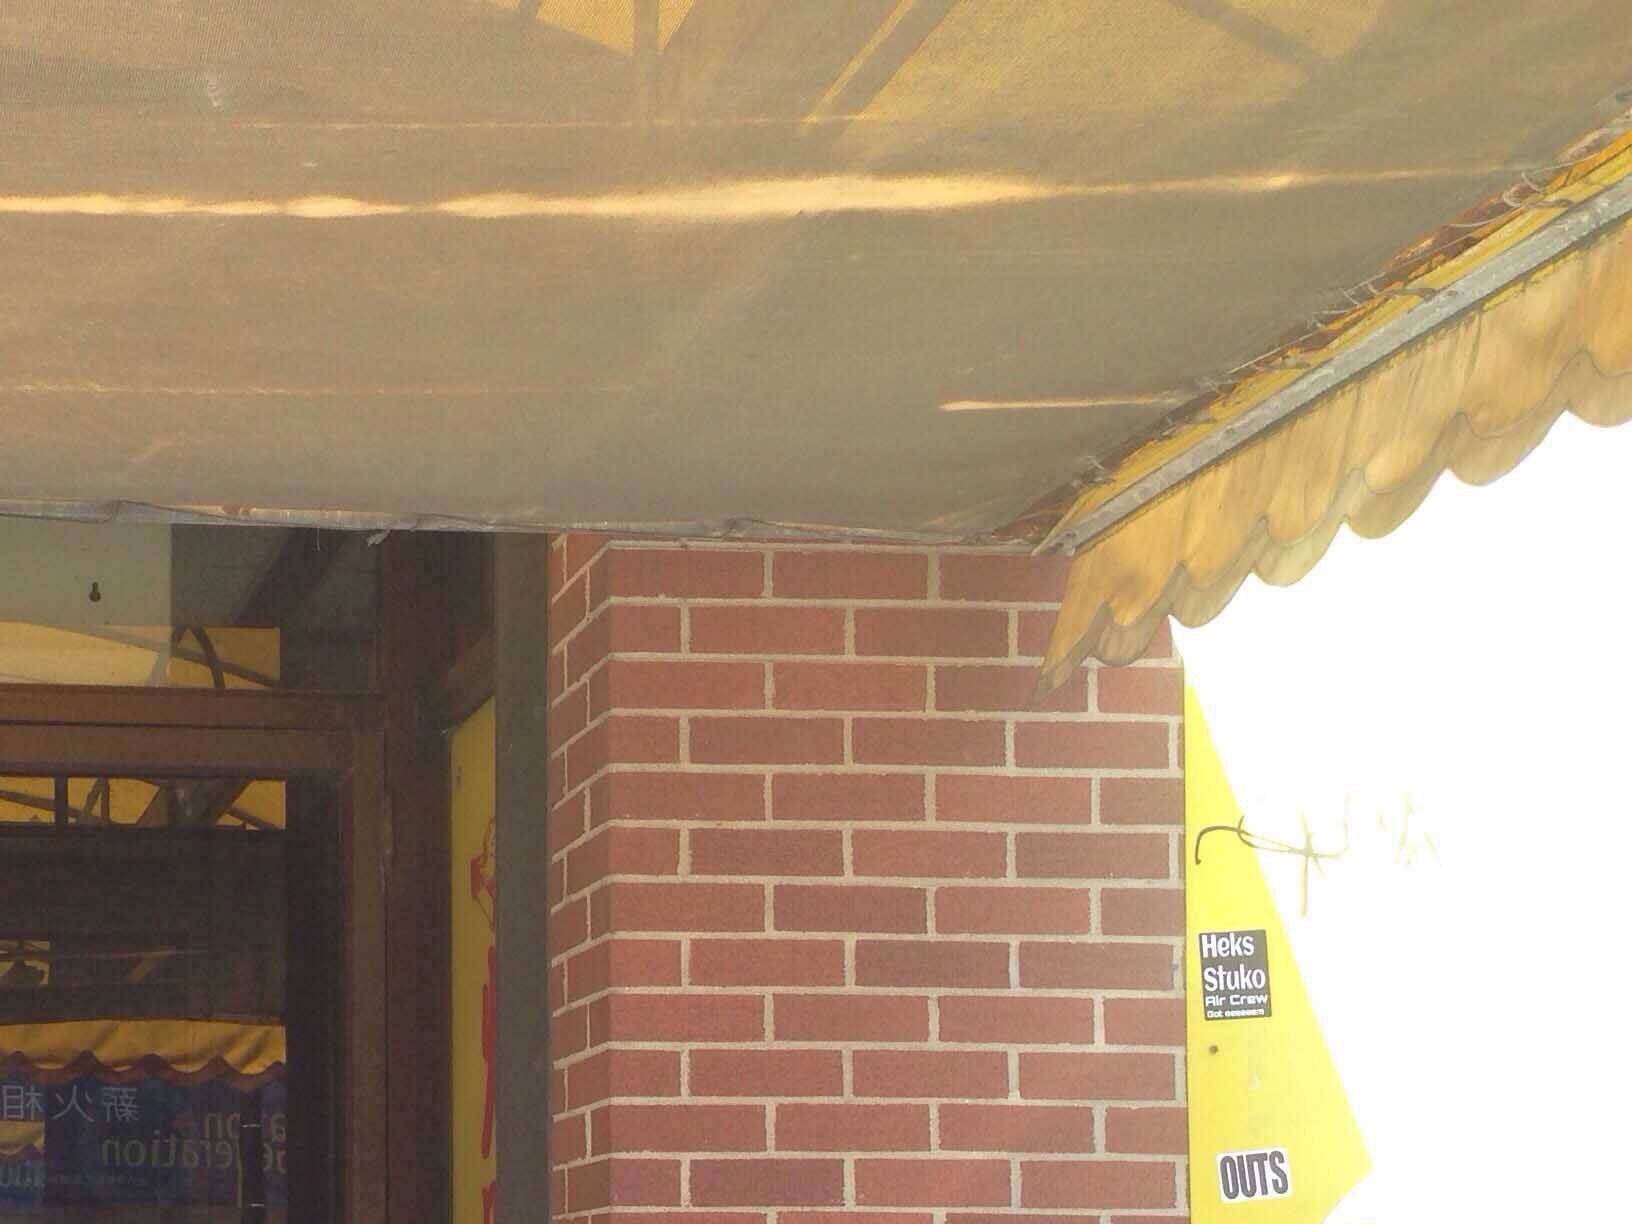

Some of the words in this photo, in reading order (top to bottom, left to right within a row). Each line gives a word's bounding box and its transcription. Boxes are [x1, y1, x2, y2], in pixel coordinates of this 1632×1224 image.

[1201, 932, 1255, 958] Heks
[1203, 963, 1266, 992] Stuko
[1205, 995, 1226, 1007] Air
[1229, 993, 1268, 1005] Crew
[1219, 1150, 1289, 1200] OUTS
